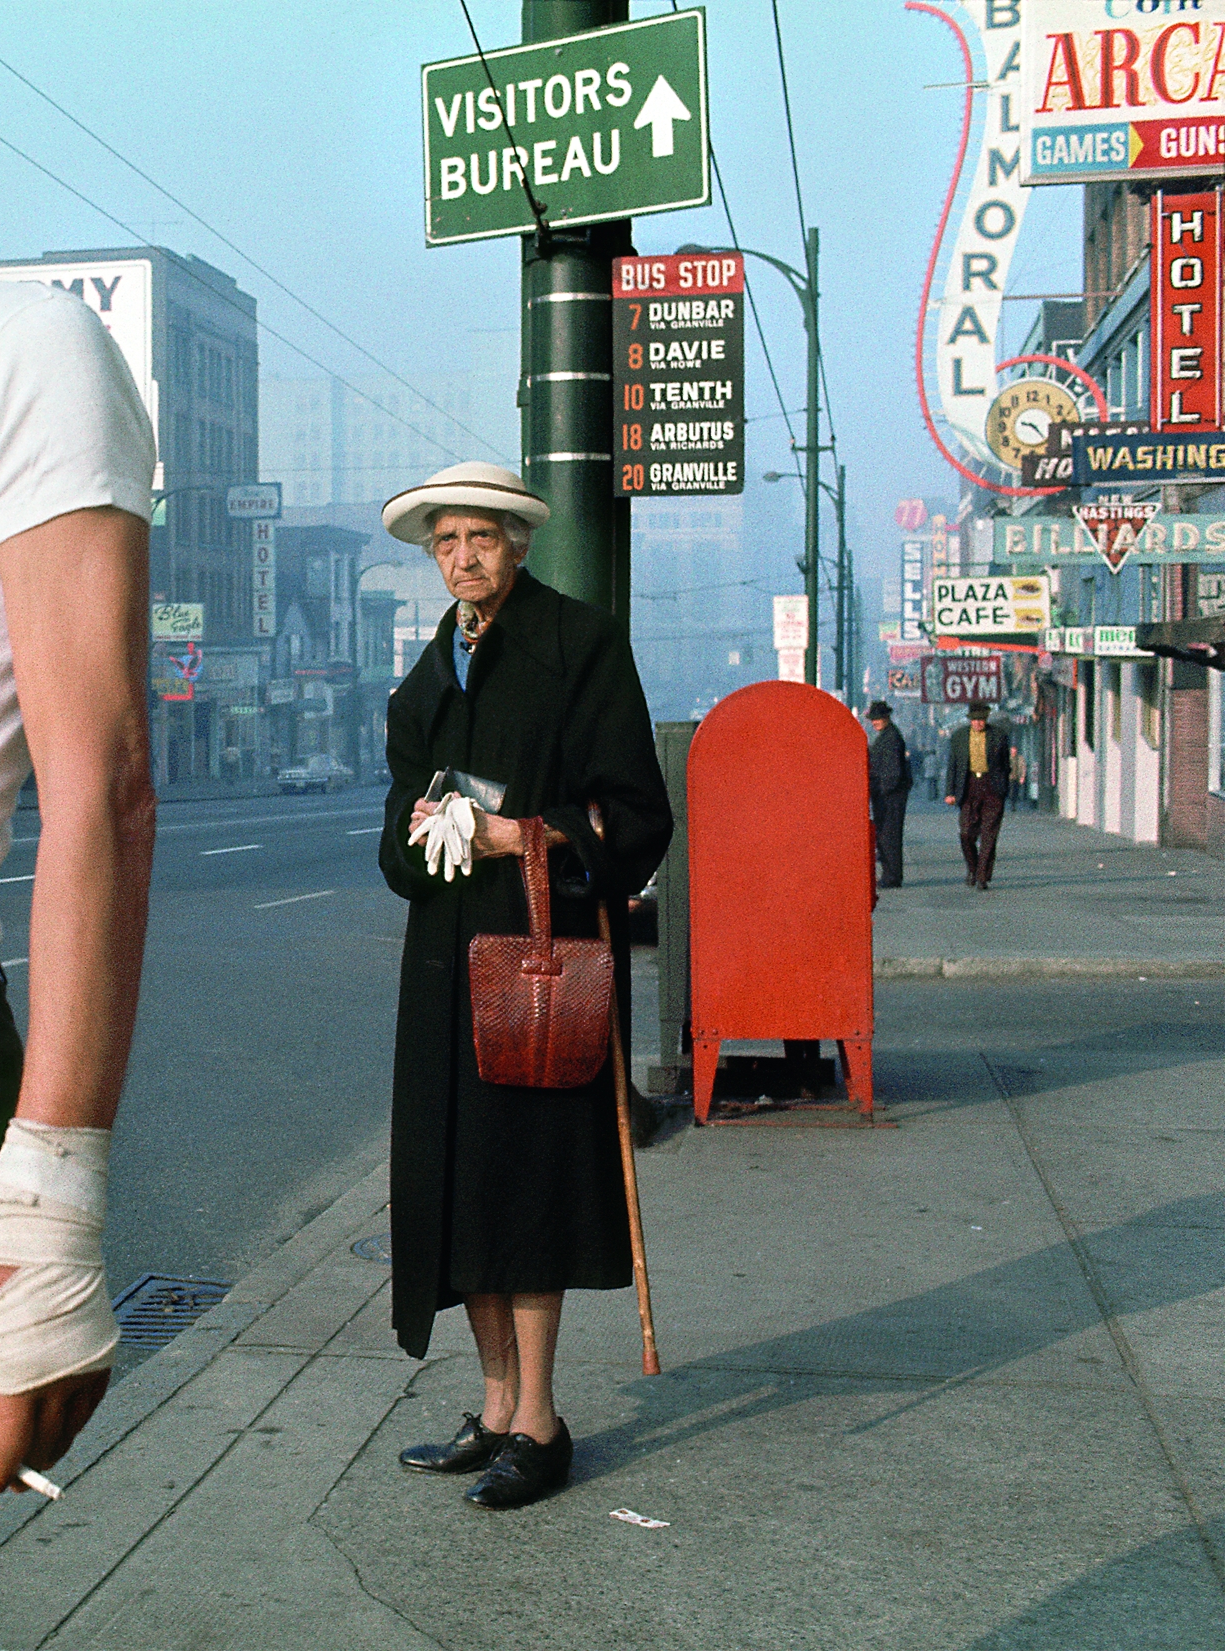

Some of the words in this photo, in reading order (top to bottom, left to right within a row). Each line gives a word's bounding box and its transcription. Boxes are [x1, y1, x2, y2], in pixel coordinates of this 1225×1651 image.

[435, 61, 633, 138] VISITORS
[1036, 131, 1124, 165] GAMES
[440, 129, 620, 200] BUREAU
[621, 263, 666, 291] BUS
[678, 259, 736, 289] STOP
[628, 303, 642, 330] 7
[649, 299, 734, 321] DUNBAR
[650, 321, 666, 330] VIA
[671, 319, 724, 329] GRANVILLE
[1171, 210, 1203, 423] HOTEL
[628, 343, 643, 369] 8
[649, 340, 725, 361] DAVIE
[650, 361, 666, 369] VIA
[671, 360, 702, 369] HOWE
[624, 383, 644, 411] 10
[649, 380, 732, 401] TENTH
[650, 402, 666, 410] VIA
[671, 400, 725, 409] GRANVILLE
[622, 423, 642, 451] 18
[650, 421, 734, 441] ARBUTUS
[650, 442, 666, 451] VIA
[670, 441, 724, 450] RICHARDS
[622, 463, 644, 491] 20
[650, 462, 737, 482] GRANVILLE
[651, 482, 667, 491] VIA
[672, 481, 726, 490] GRANVILLE
[230, 500, 274, 510] EMPIRE
[1079, 506, 1154, 519] HASTINGS
[1098, 494, 1133, 504] NEW
[1006, 521, 1225, 555] BILLIARDS
[257, 523, 269, 633] HOTEL
[938, 583, 1008, 602] PLAZA
[938, 606, 1010, 626] CAFE
[946, 675, 997, 699] GYM
